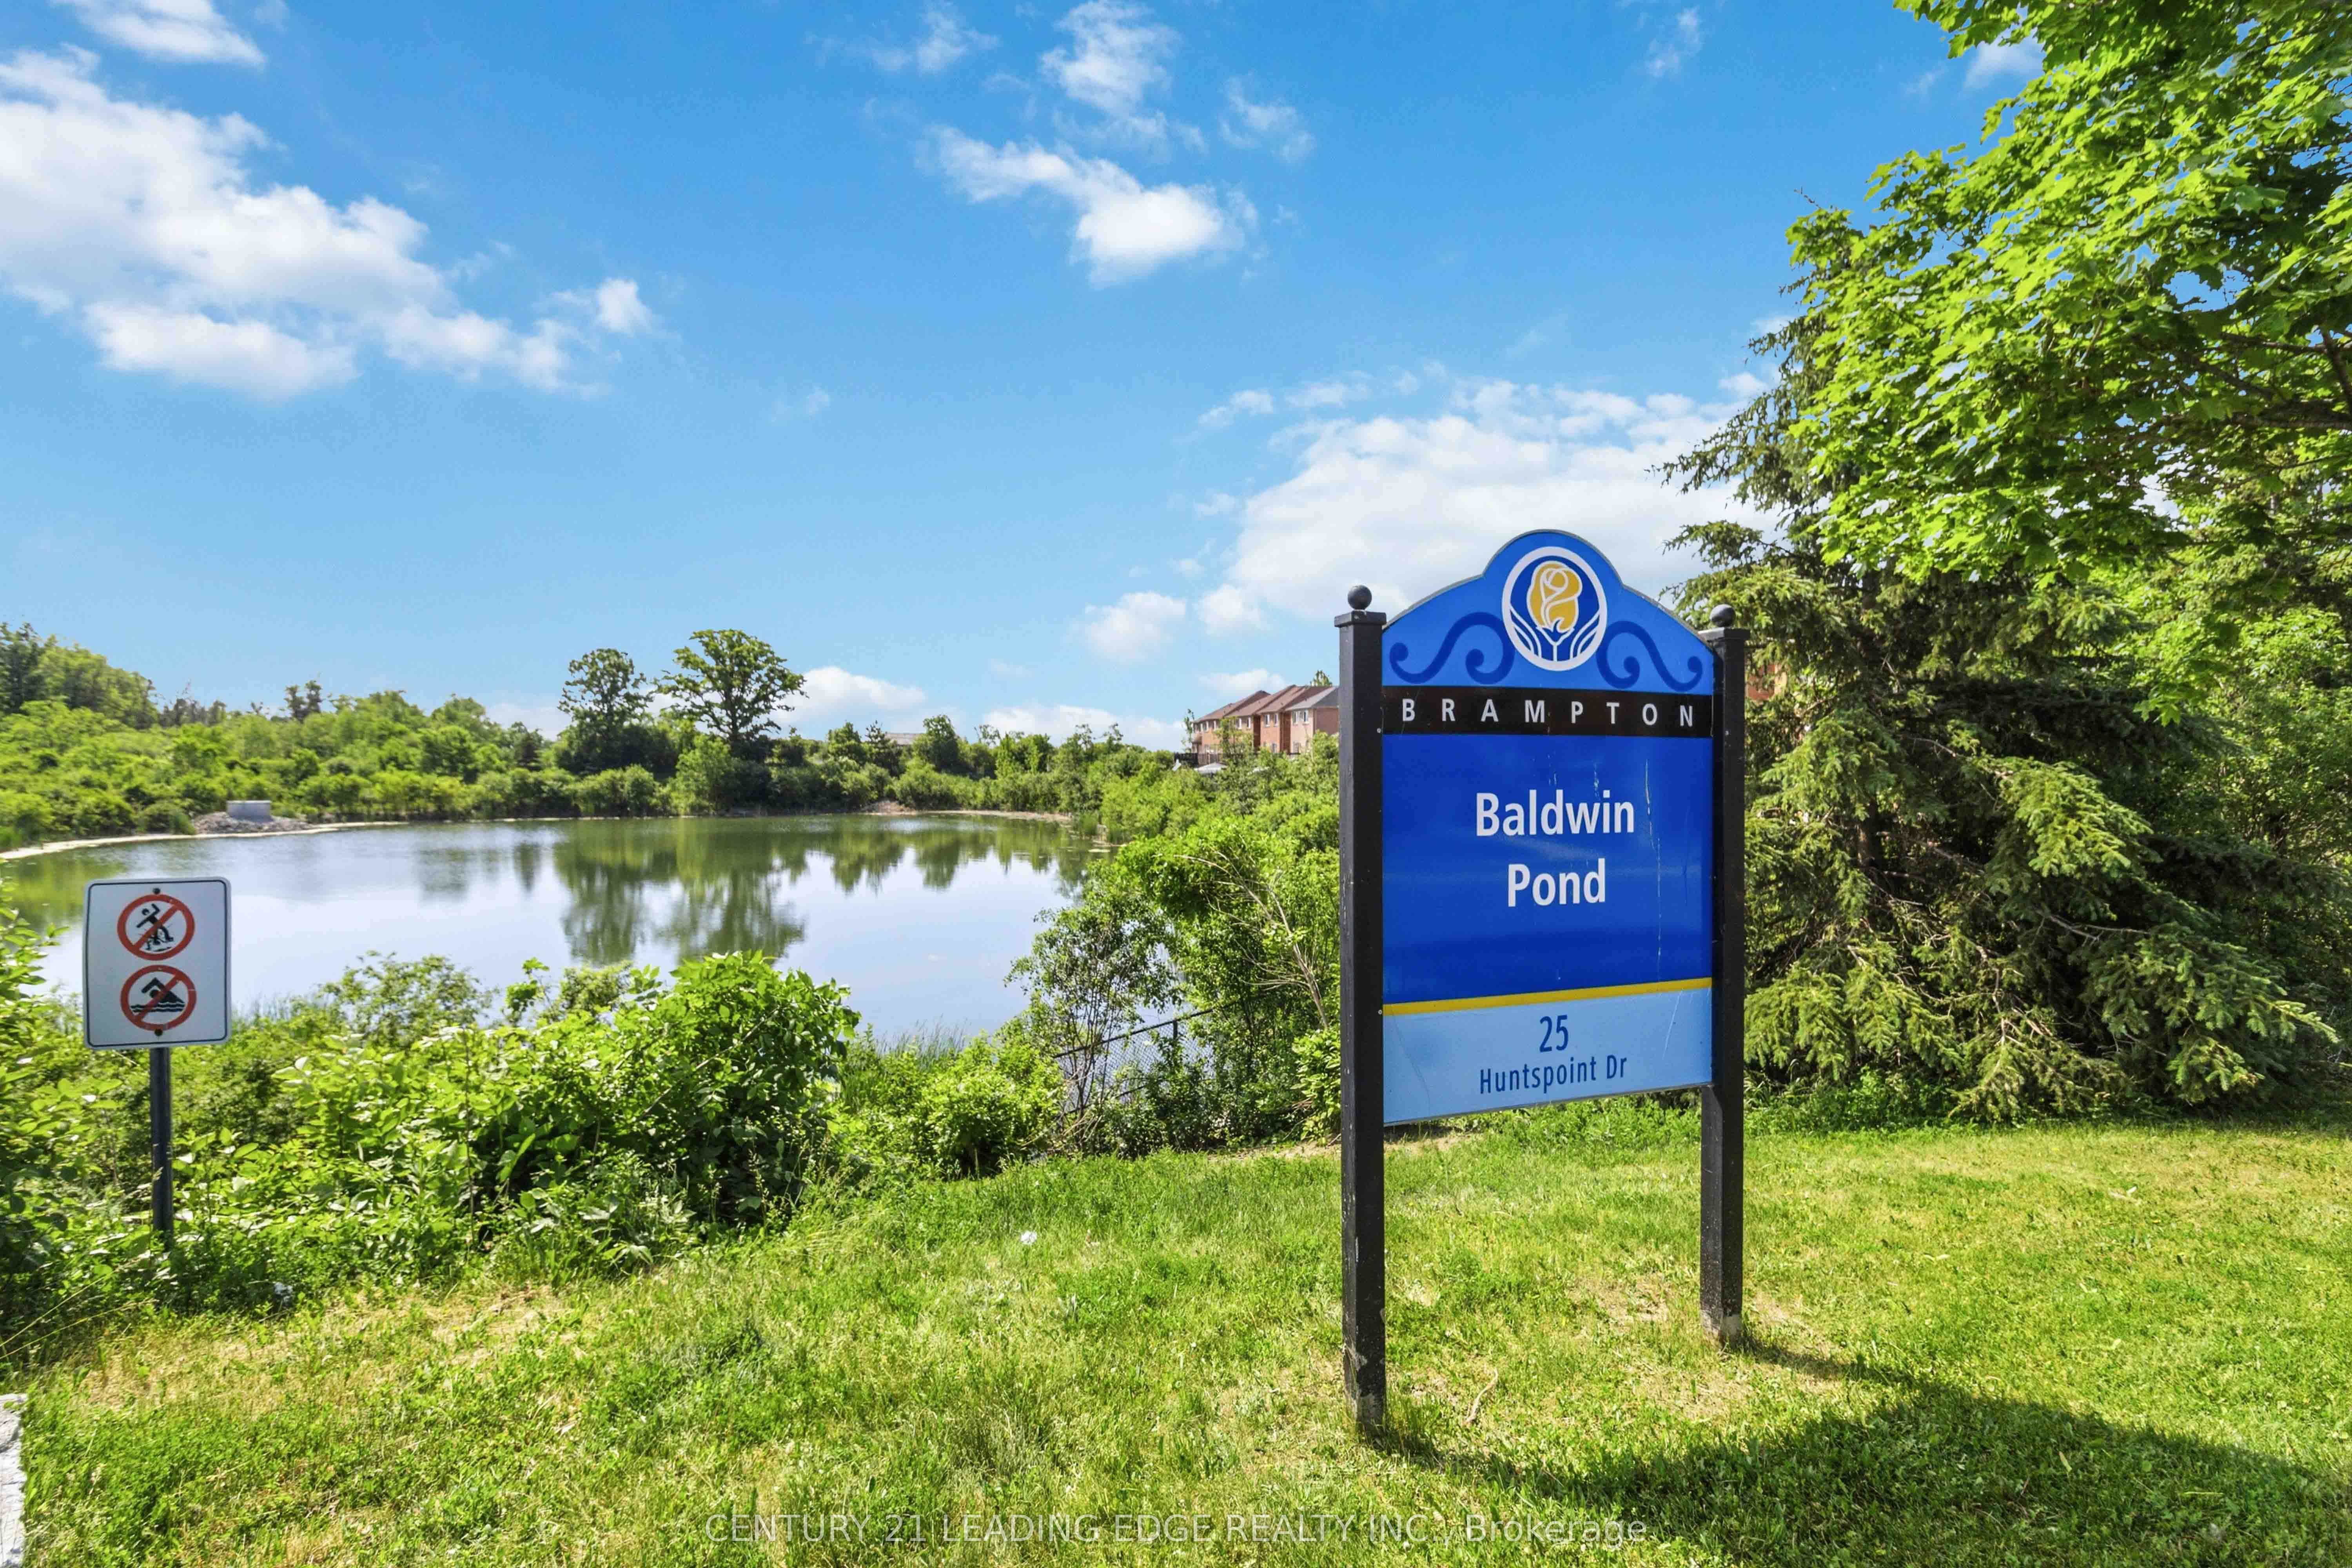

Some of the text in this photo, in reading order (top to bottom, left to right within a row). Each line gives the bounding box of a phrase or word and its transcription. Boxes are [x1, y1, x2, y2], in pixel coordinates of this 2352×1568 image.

[1402, 699, 1693, 727] BRAMPTON
[1476, 789, 1634, 836] Baldwin
[1508, 858, 1605, 907] Pond
[1539, 1014, 1568, 1053] 25
[1480, 1054, 1627, 1094] Huntspoint Dr
